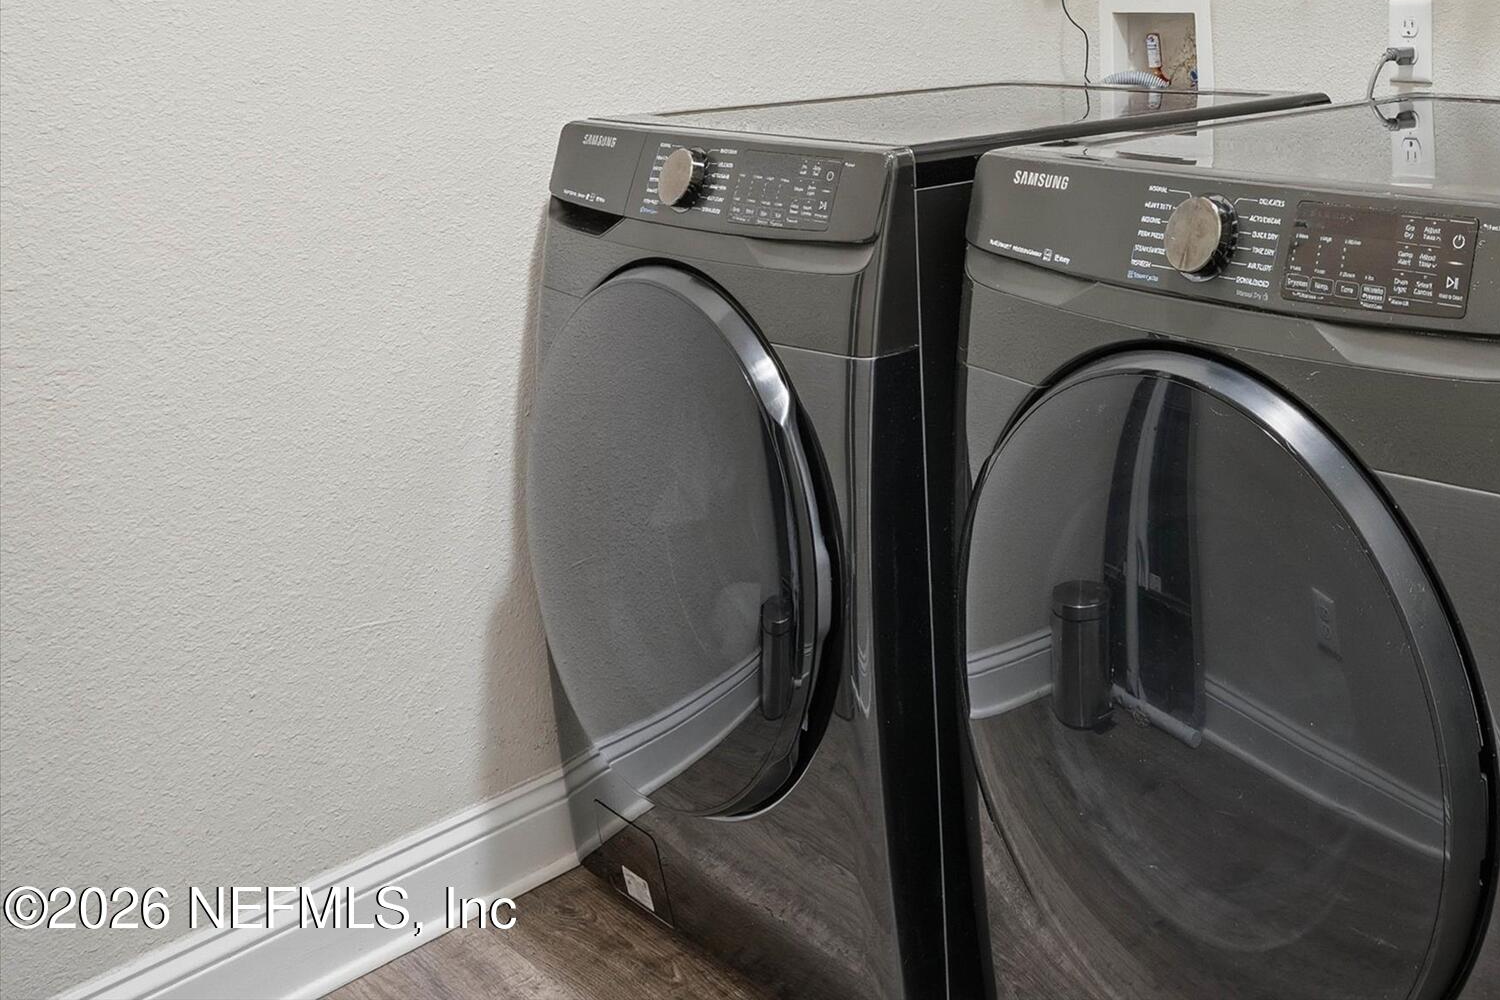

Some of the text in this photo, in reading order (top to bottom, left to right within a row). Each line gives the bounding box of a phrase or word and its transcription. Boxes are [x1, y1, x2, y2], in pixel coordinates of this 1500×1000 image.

[582, 133, 617, 148] SAMSUNG
[1013, 169, 1069, 190] SAMSUNG
[1267, 232, 1279, 240] DRY
